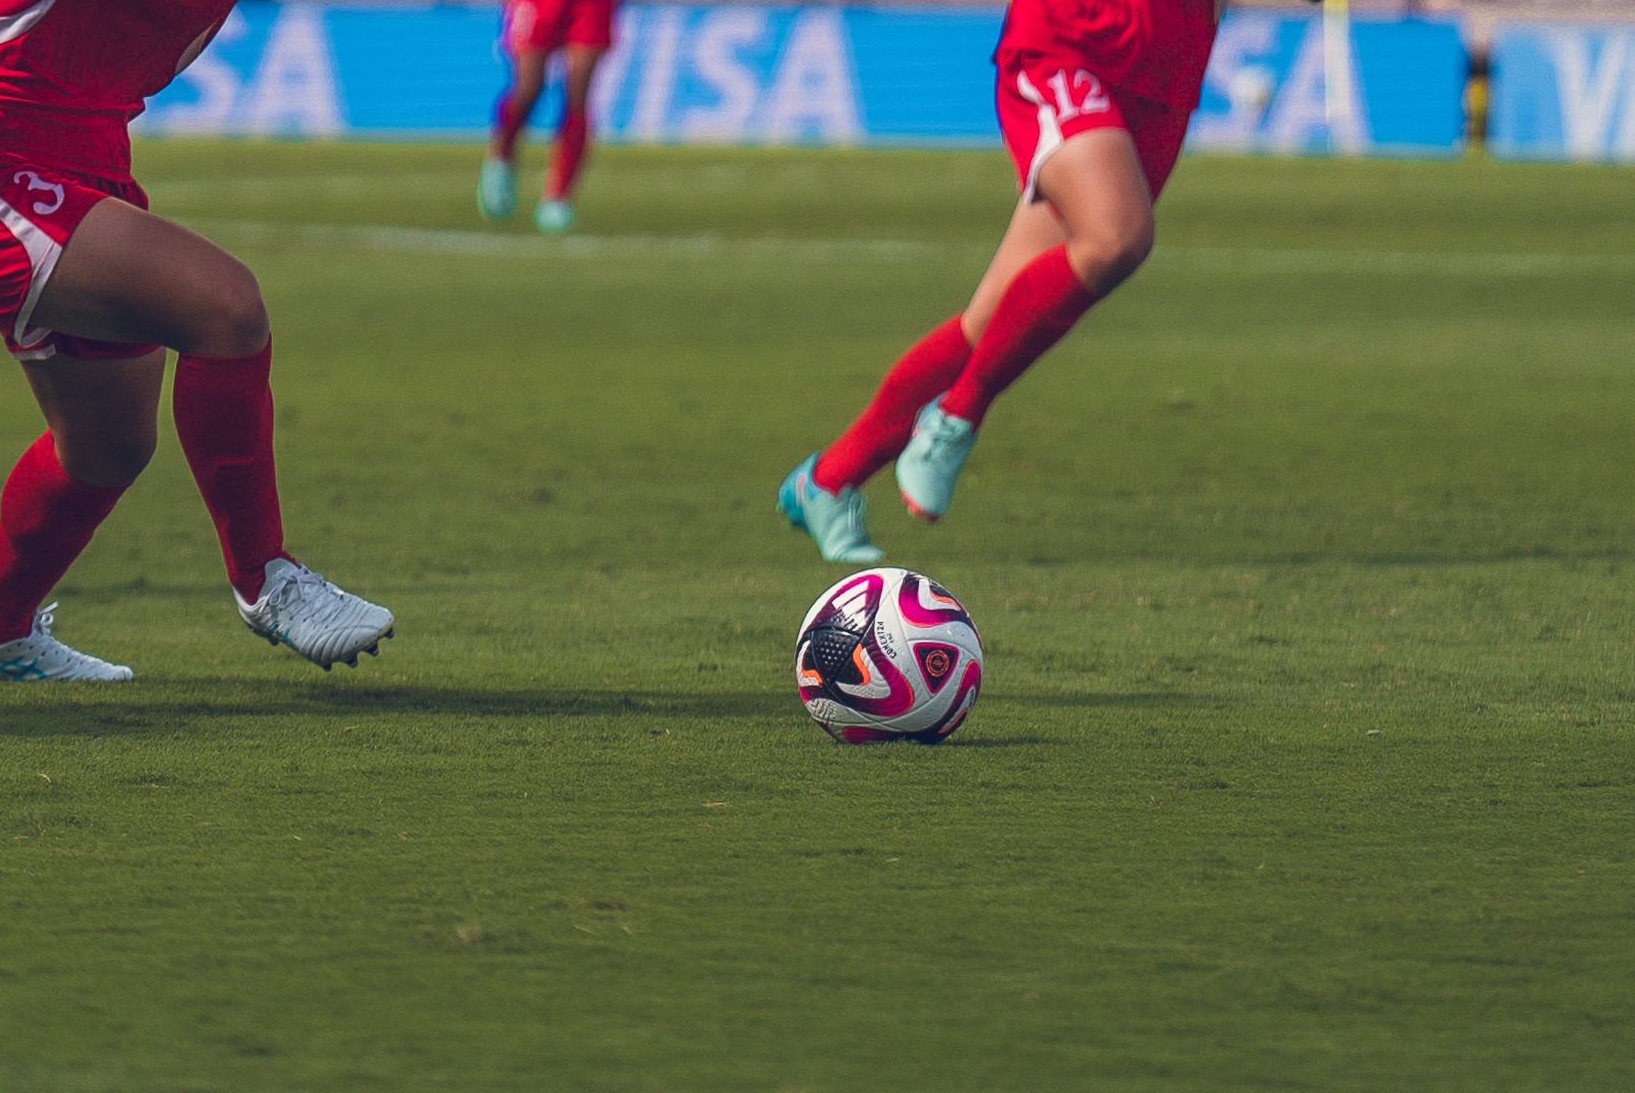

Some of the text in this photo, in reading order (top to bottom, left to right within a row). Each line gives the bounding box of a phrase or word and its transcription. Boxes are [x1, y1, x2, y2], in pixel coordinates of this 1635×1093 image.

[149, 1, 349, 137] SA
[1047, 68, 1111, 121] 12
[1189, 13, 1372, 152] SA
[14, 171, 64, 215] 3
